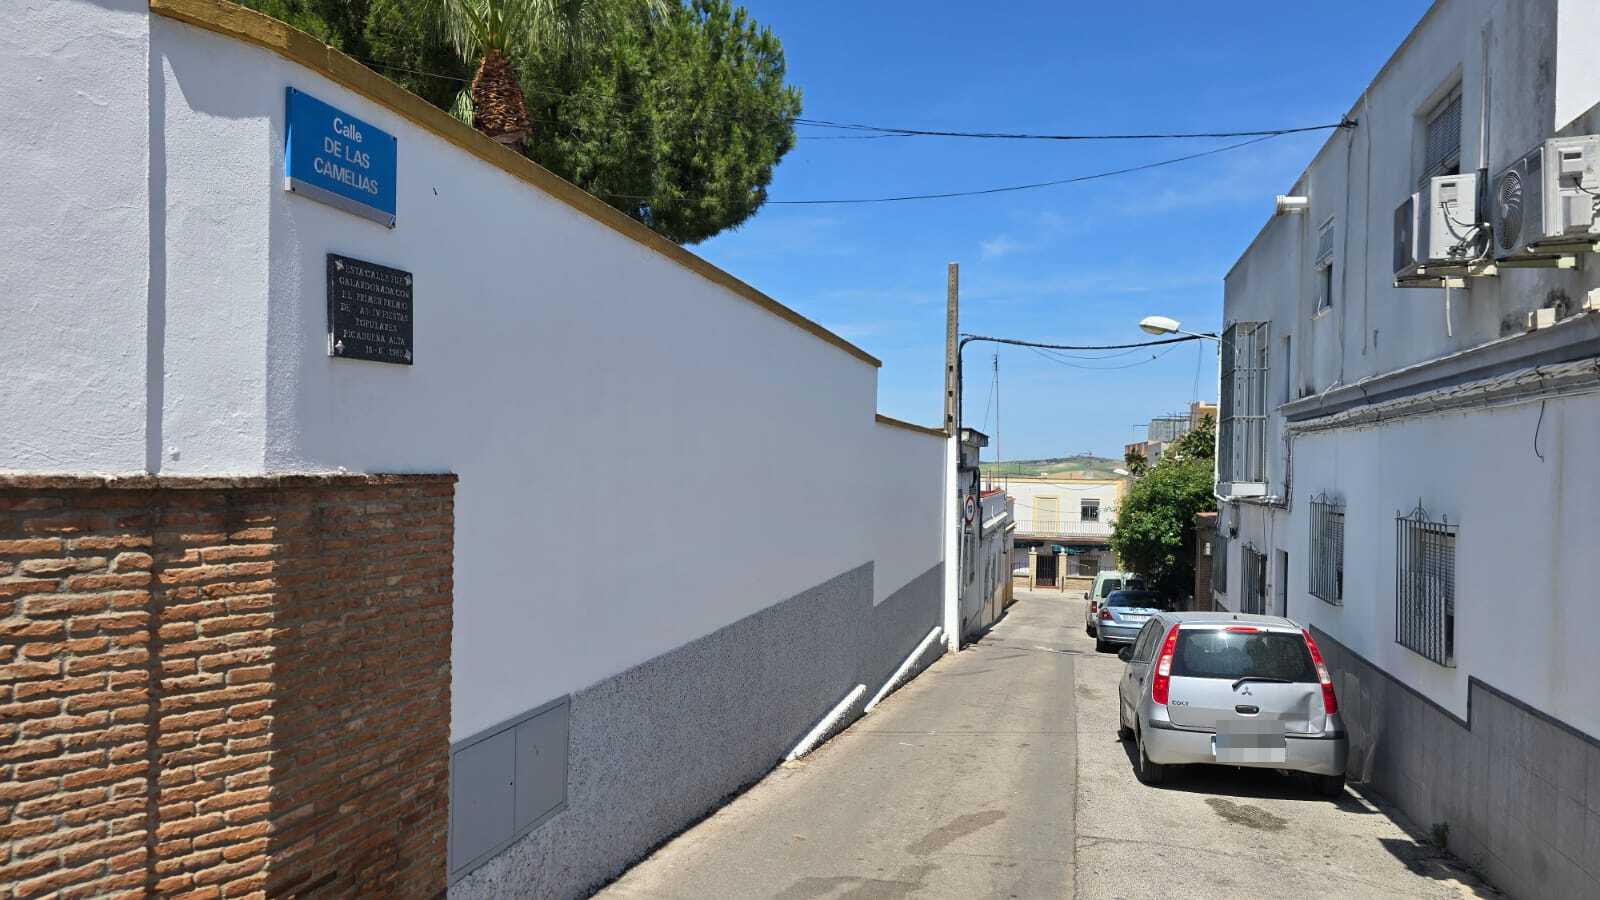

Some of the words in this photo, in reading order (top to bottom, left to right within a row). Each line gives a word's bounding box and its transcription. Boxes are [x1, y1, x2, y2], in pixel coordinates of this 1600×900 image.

[334, 118, 362, 143] Calle
[326, 137, 341, 158] DE
[346, 146, 370, 169] LAS
[314, 158, 378, 195] CAMELIAS
